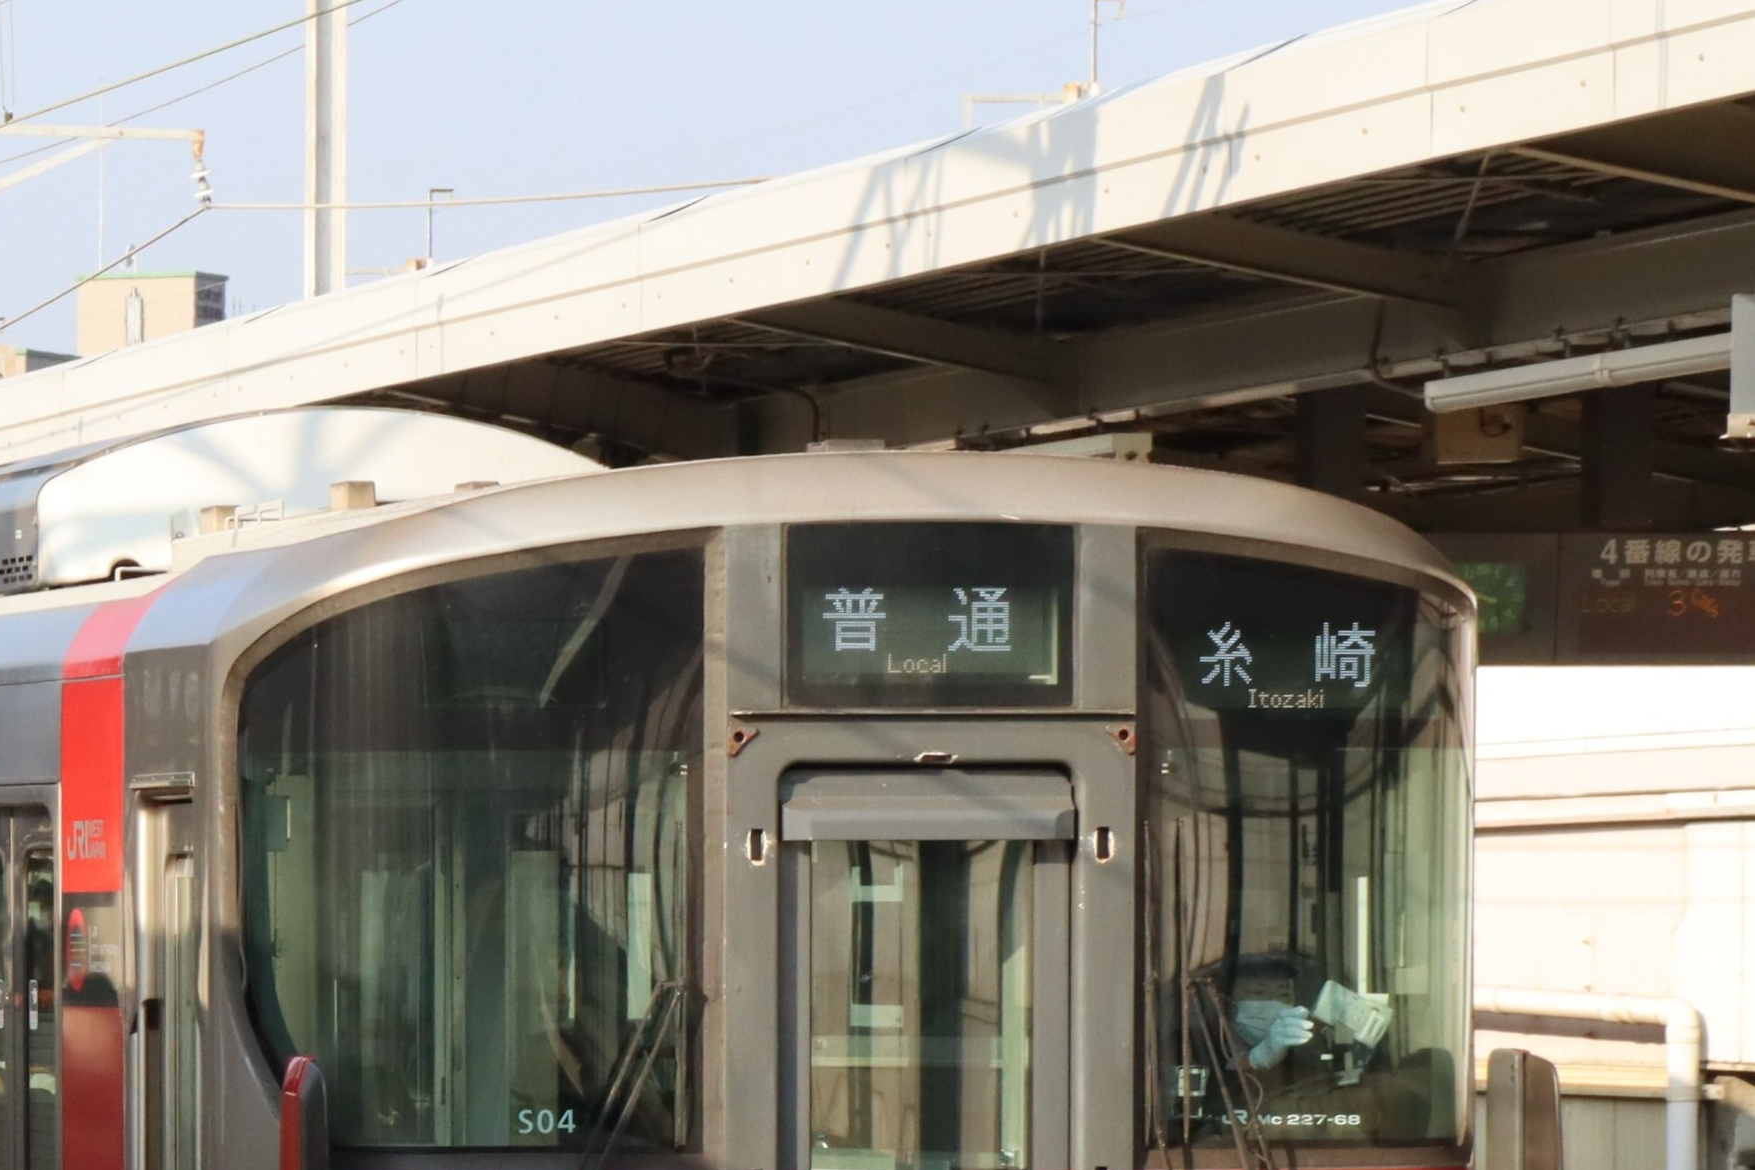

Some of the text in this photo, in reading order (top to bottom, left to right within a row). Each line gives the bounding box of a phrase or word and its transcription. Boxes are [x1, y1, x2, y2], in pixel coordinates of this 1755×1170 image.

[1600, 537, 1755, 564] 4番線の発
[822, 586, 1012, 651] 普通
[887, 653, 947, 674] Local
[1199, 621, 1376, 687] 糸崎
[1248, 688, 1325, 709] Itozaki
[518, 1108, 577, 1134] S04
[1287, 1114, 1361, 1126] 227-68
